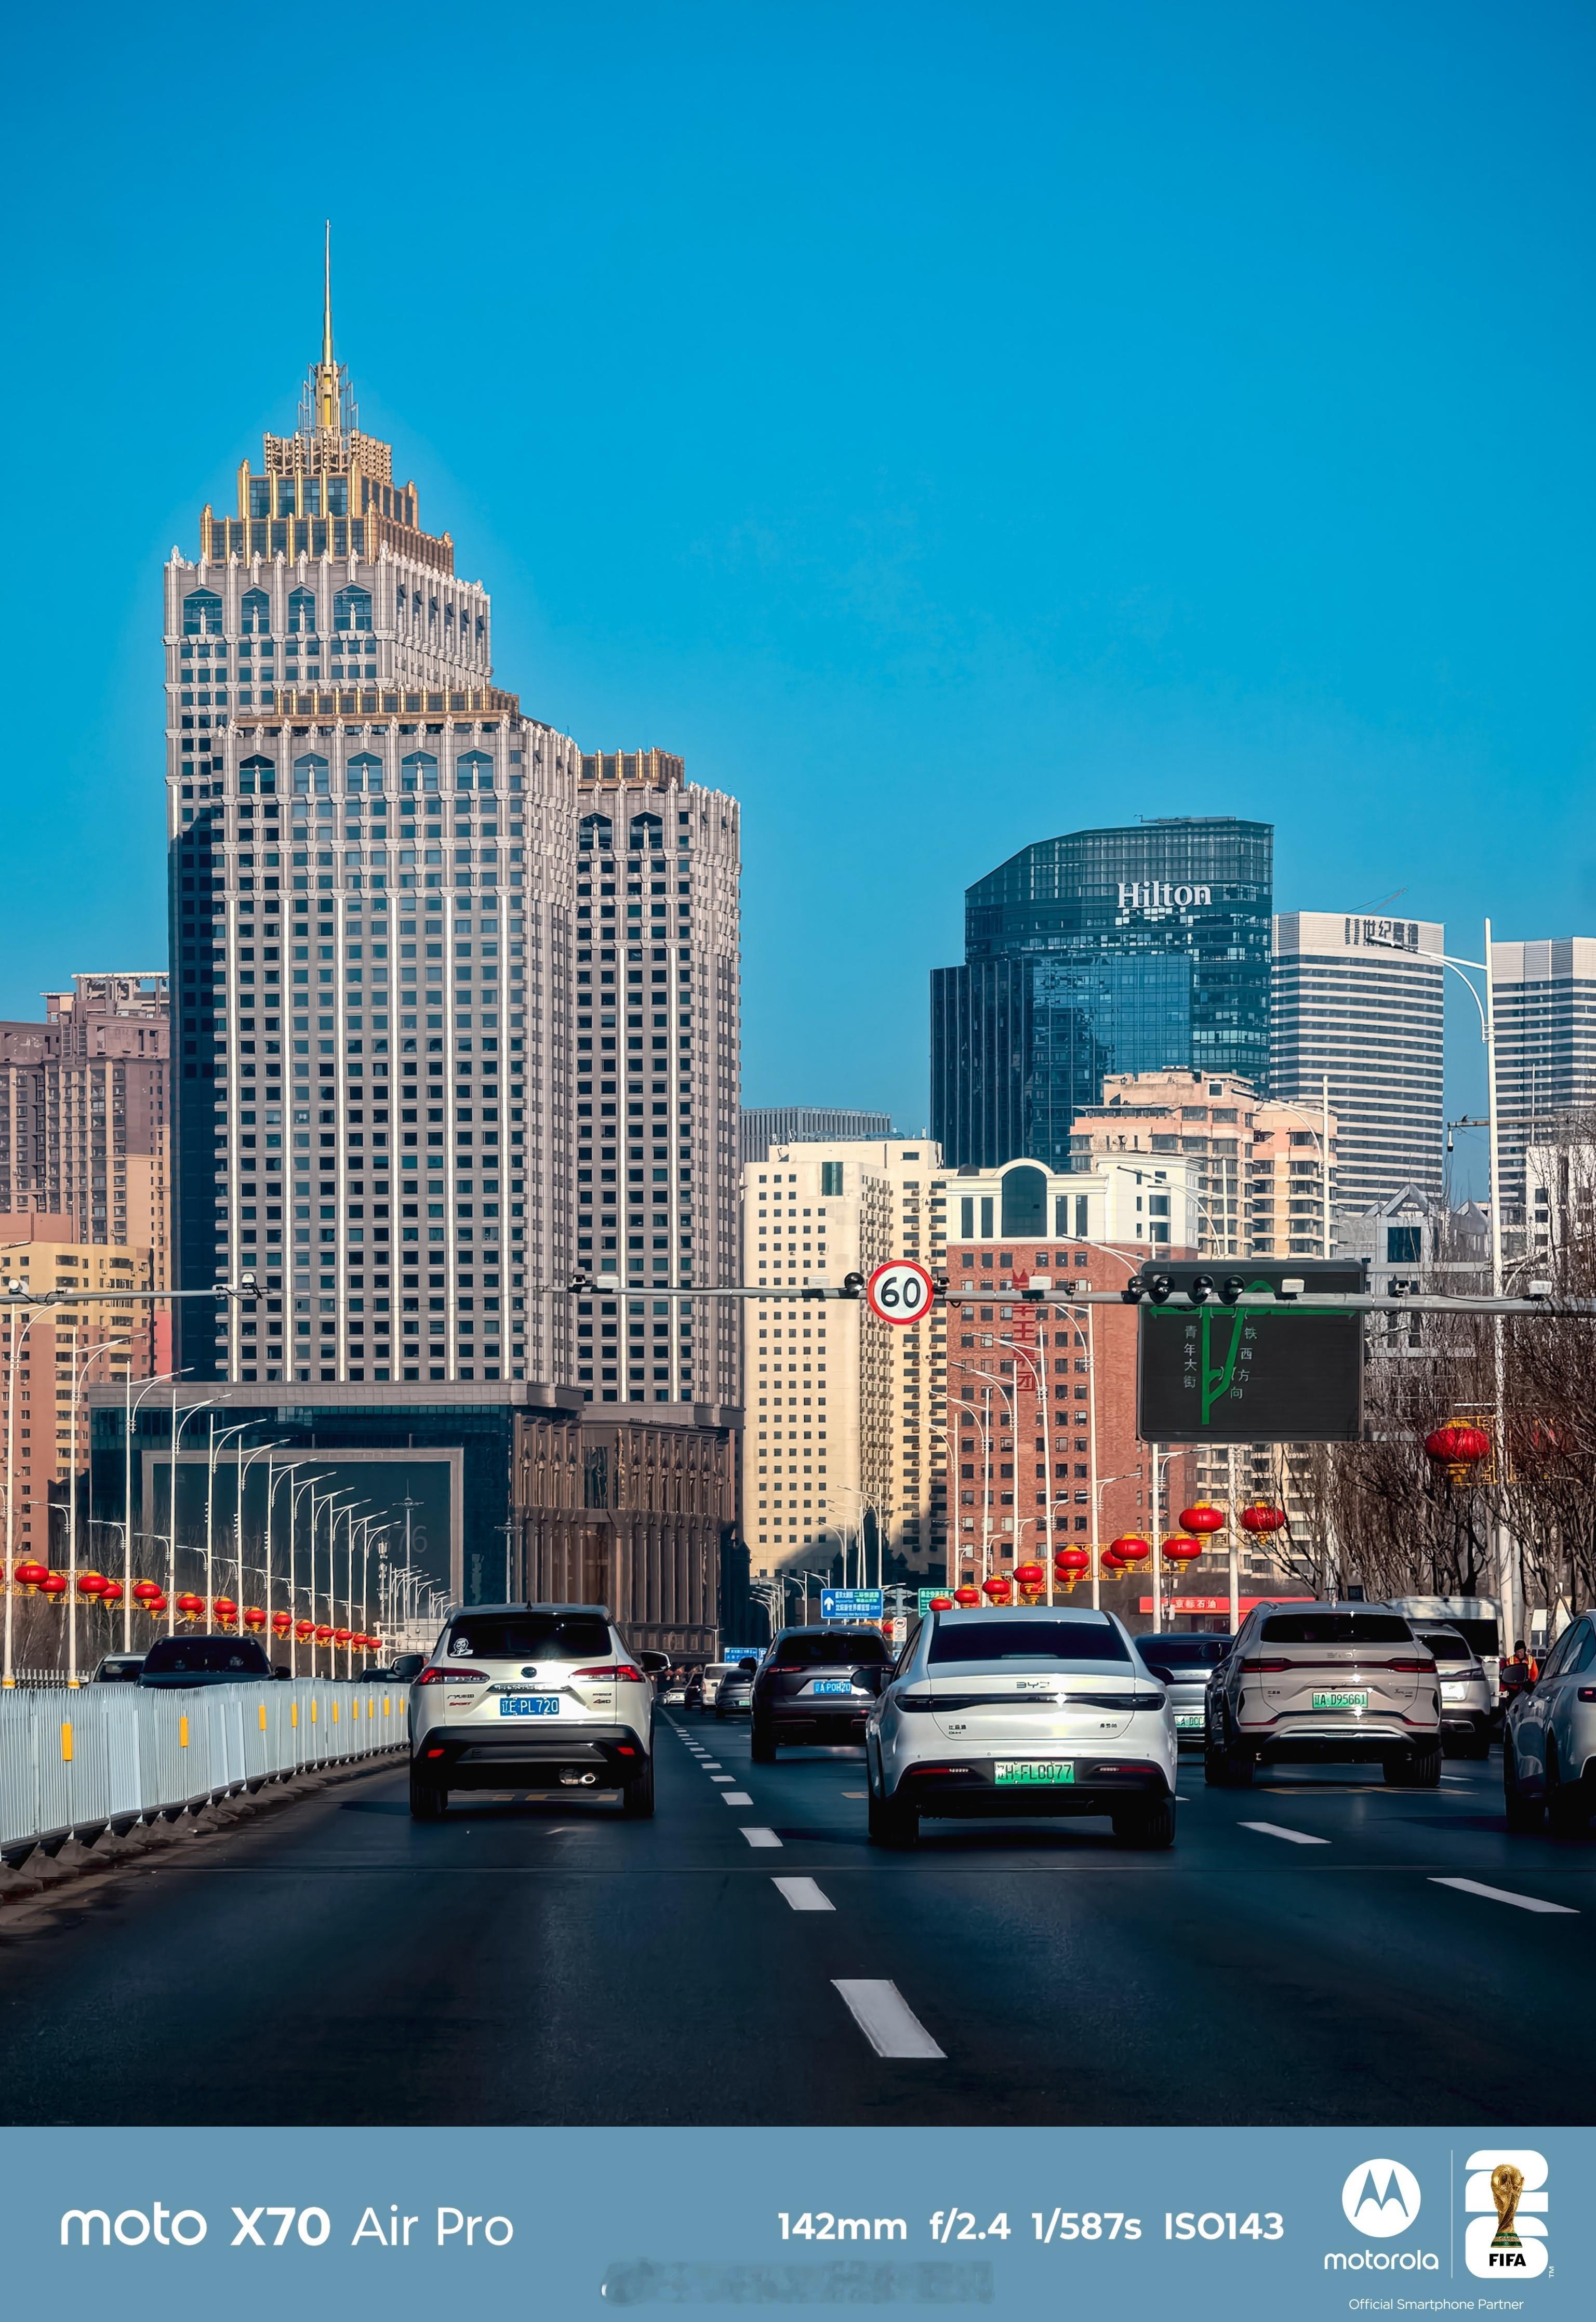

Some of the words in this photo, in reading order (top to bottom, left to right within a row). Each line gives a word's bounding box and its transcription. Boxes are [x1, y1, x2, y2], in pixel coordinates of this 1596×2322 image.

[1117, 881, 1212, 908] Hilton
[881, 1277, 921, 1308] 60
[1183, 1325, 1198, 1388] 青年大街
[1230, 1327, 1257, 1399] 铁西方向
